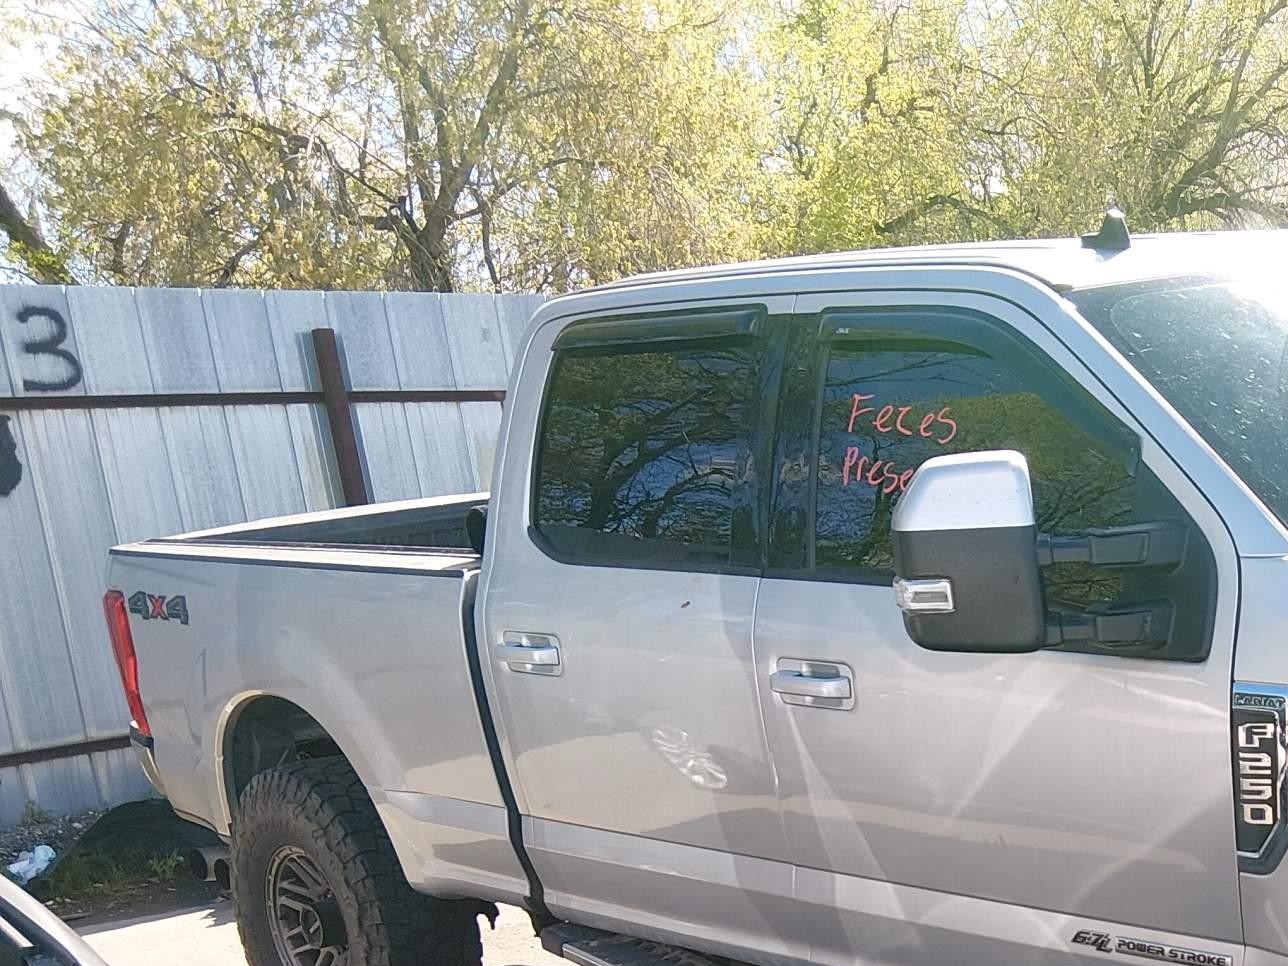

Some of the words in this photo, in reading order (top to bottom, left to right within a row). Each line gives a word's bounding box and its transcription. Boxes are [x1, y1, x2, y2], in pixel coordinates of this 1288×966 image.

[16, 304, 84, 392] 3
[847, 393, 957, 445] Feces
[842, 446, 914, 494] Prese
[1238, 722, 1275, 825] F250
[1117, 939, 1165, 956] POWER
[1168, 949, 1226, 966] STROKE
